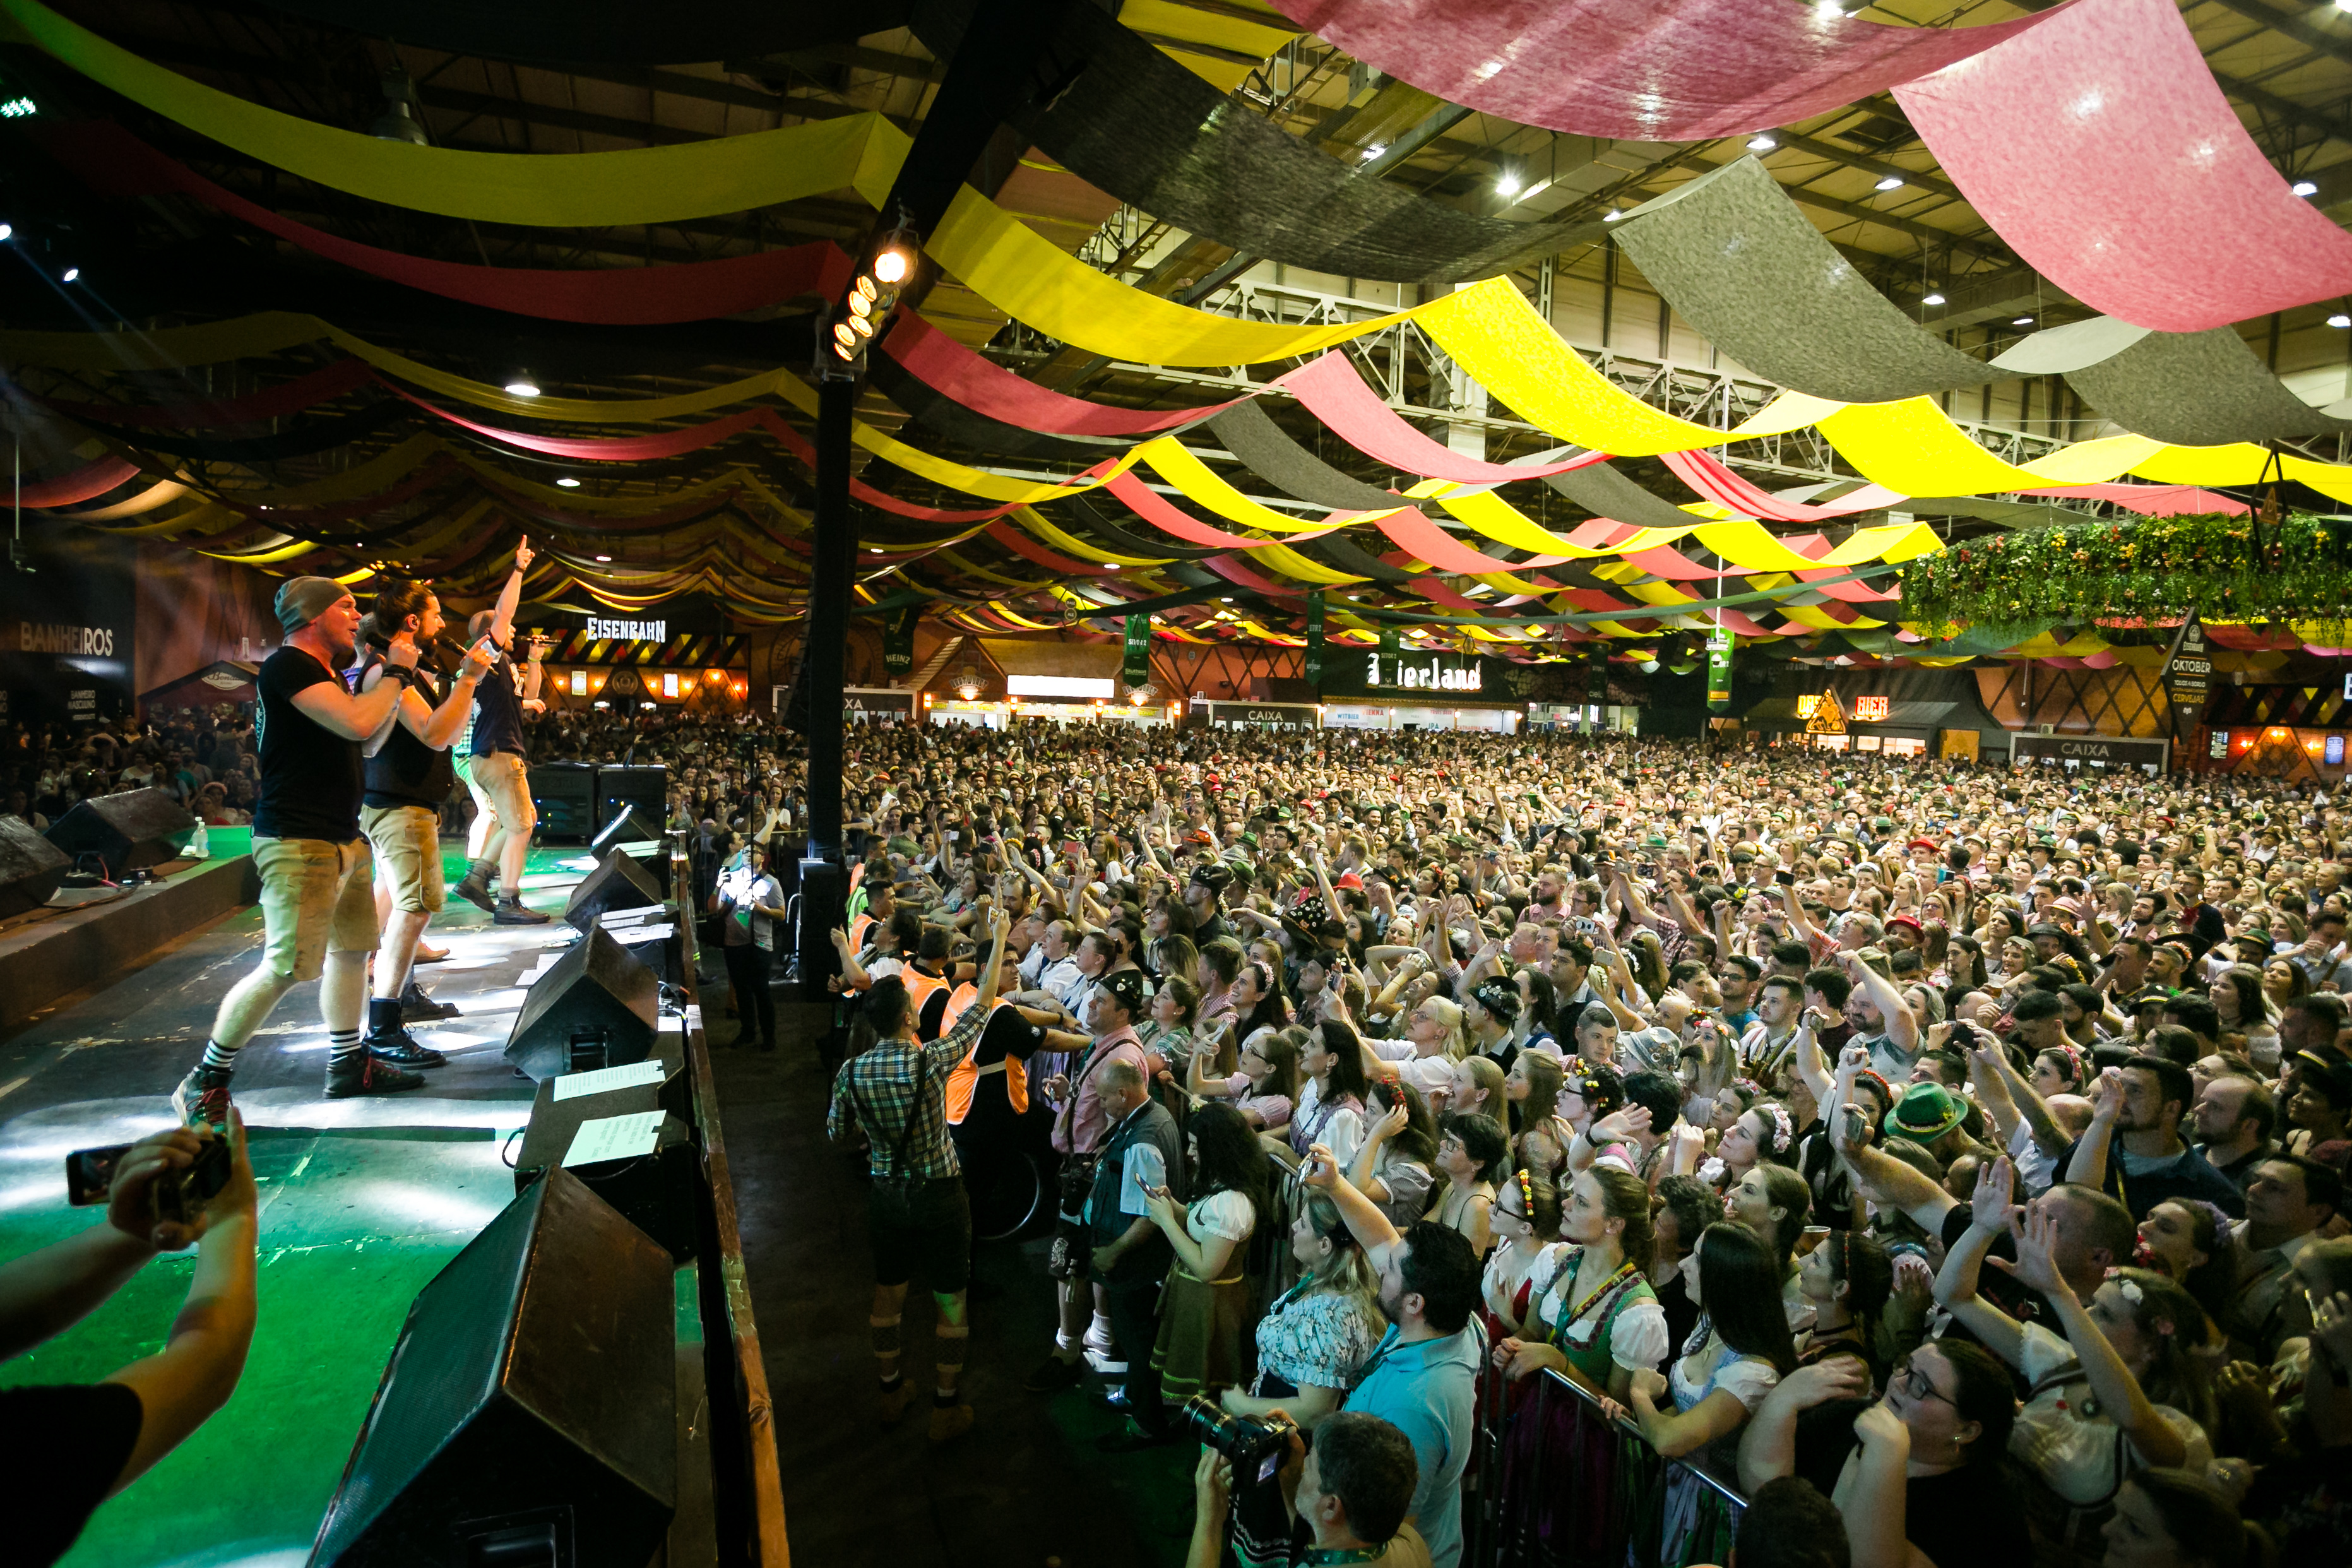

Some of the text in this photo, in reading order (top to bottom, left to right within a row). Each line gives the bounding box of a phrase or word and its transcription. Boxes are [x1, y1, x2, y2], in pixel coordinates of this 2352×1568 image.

[587, 617, 666, 643] EISENBAHN
[20, 621, 113, 656] BANHEIROS
[886, 654, 911, 665] HEINZ
[2172, 659, 2211, 674] OKTOBER
[1856, 696, 1889, 716] BIER
[2173, 693, 2205, 704] CERVEJAS
[1248, 710, 1283, 721] CAIXA
[2061, 742, 2109, 757] CAIXA
